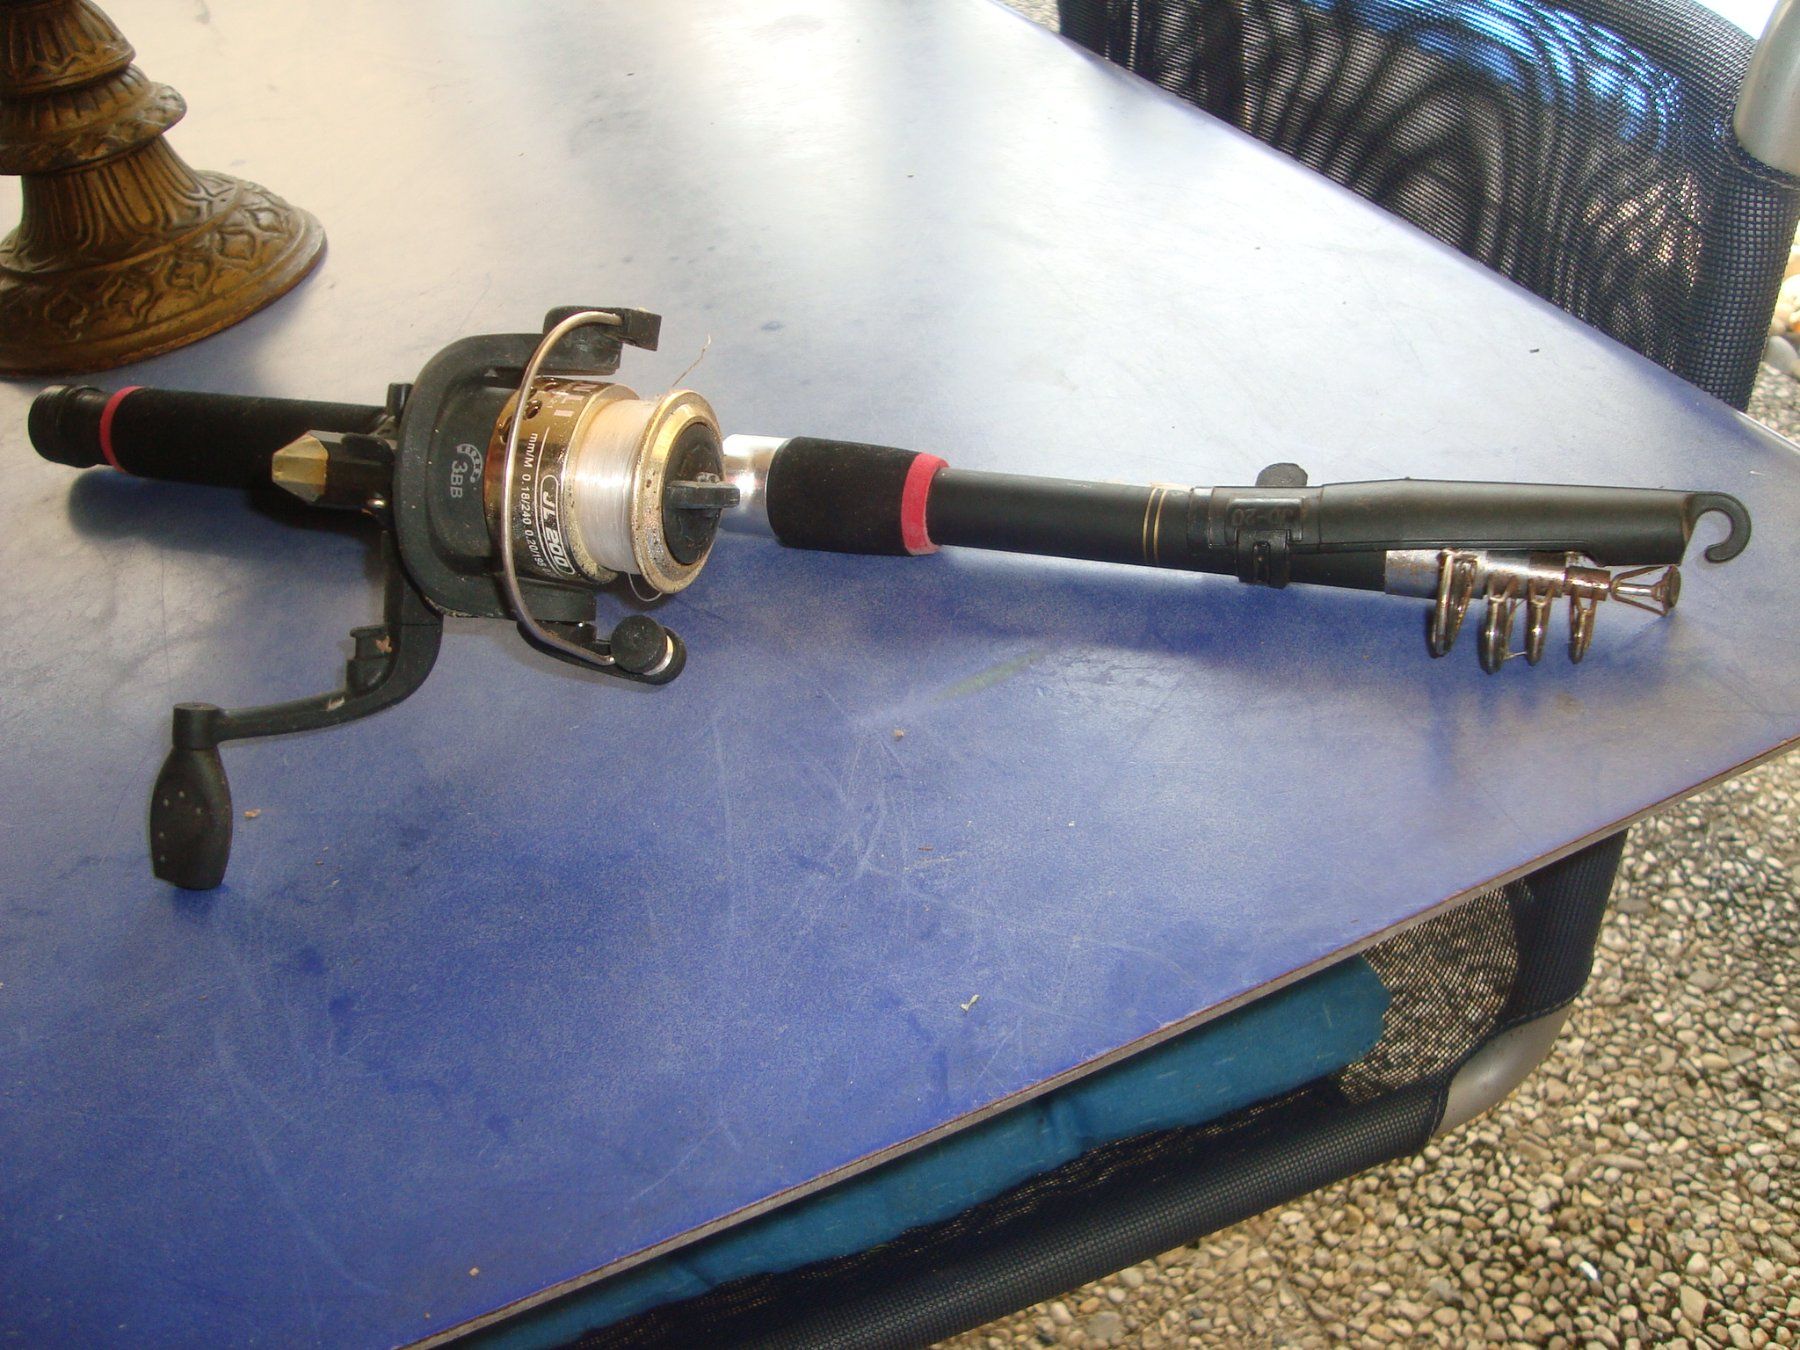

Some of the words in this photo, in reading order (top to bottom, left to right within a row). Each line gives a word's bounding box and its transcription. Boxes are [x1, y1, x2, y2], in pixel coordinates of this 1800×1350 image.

[523, 432, 539, 468] mm/M
[450, 460, 468, 498] 3BB
[520, 473, 536, 526] 0.18/240
[542, 491, 556, 520] JL
[545, 527, 569, 568] 200
